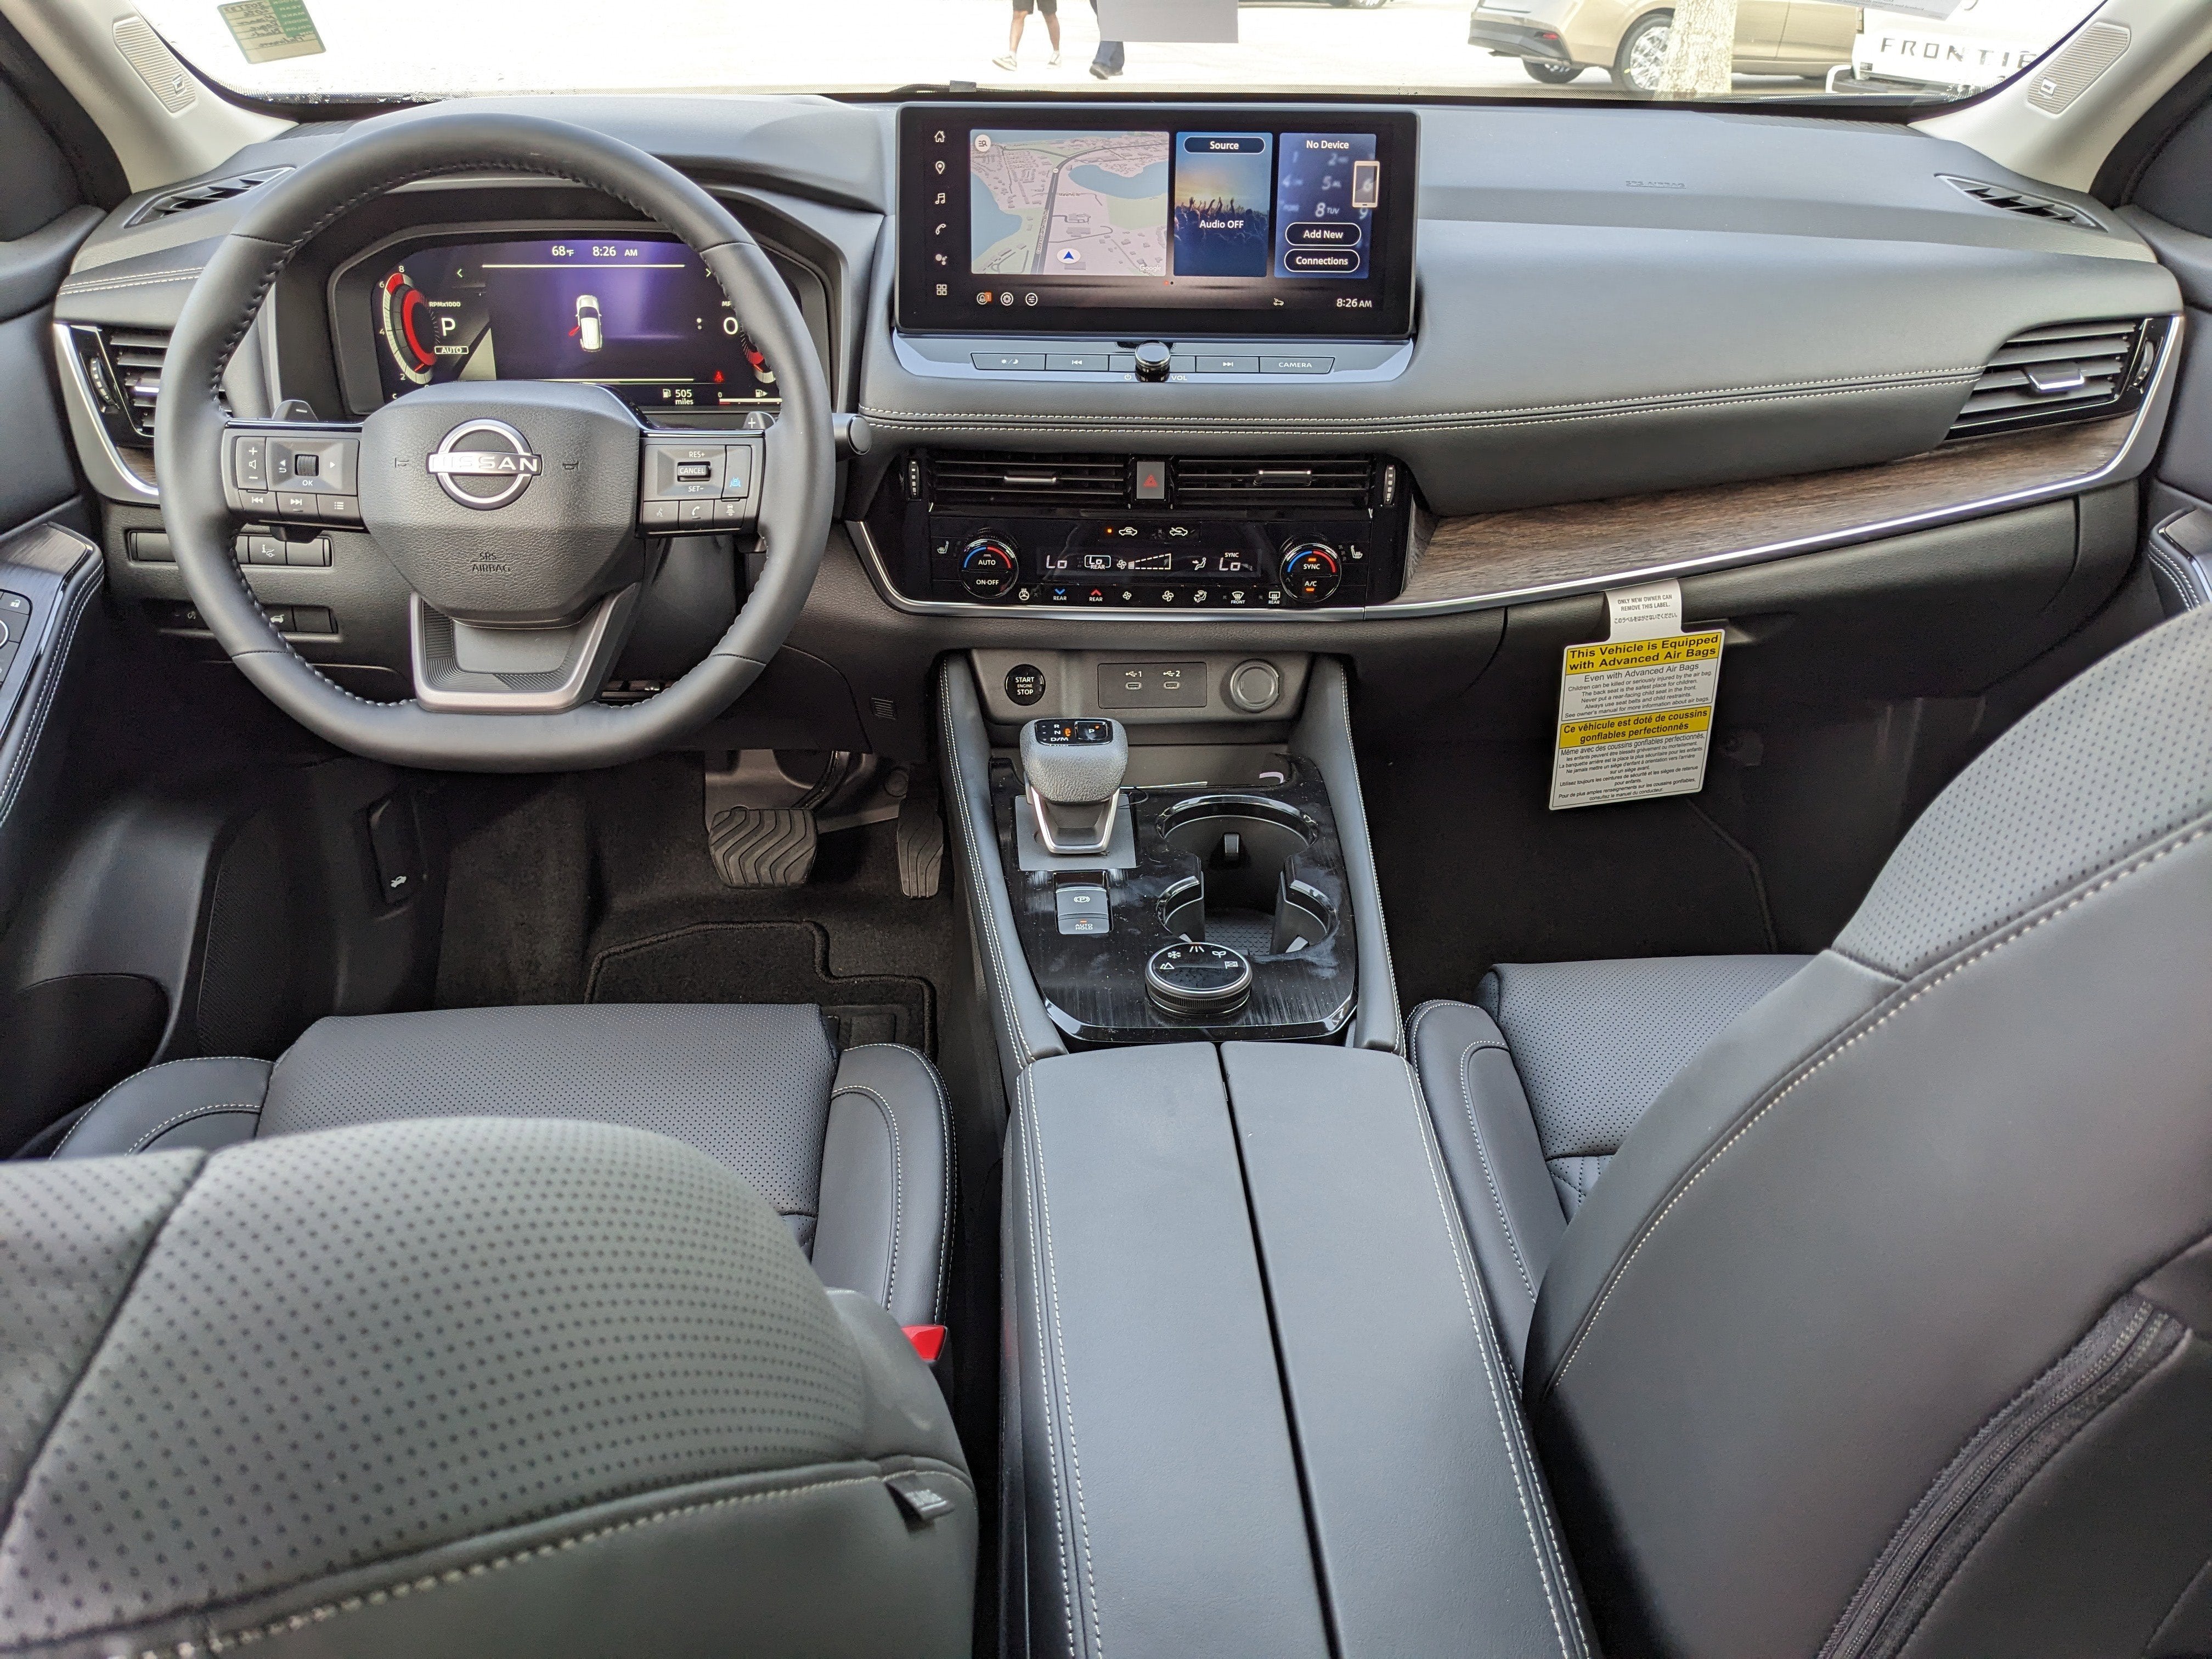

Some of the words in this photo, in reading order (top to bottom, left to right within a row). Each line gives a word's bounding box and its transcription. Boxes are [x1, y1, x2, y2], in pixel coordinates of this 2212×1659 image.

[1210, 140, 1239, 150] Source
[1306, 140, 1319, 149] No
[1321, 140, 1350, 149] Device
[1315, 202, 1325, 217] 8
[1199, 219, 1226, 229] Audio
[1227, 220, 1244, 229] OFF
[1304, 229, 1321, 239] Add
[1323, 230, 1344, 239] New
[592, 246, 616, 256] 8:26
[1296, 256, 1348, 265] Connections
[1139, 264, 1162, 273] Google
[1336, 298, 1358, 307] 8:26
[441, 318, 456, 336] P
[675, 390, 692, 398] 505
[432, 456, 537, 472] NISSAN
[479, 551, 497, 560] SRS
[472, 563, 511, 573] AIRBAG
[1570, 649, 1595, 659] This
[1599, 644, 1644, 656] Vehicle
[1647, 642, 1657, 651] is
[1662, 635, 1718, 650] Equipped
[1569, 660, 1594, 670] with
[1599, 652, 1660, 667] Advanced
[1663, 651, 1681, 660] Air
[1686, 648, 1716, 657] Bags
[1624, 667, 1664, 678] Advanced
[1564, 725, 1576, 733] Ce
[1578, 720, 1615, 732] véhicule
[1617, 718, 1631, 727] est
[1633, 715, 1652, 725] doté
[1655, 714, 1666, 722] de
[1668, 709, 1707, 721] coussins
[1580, 730, 1626, 744] gonflables
[1628, 722, 1689, 738] perfectionnés
[1607, 742, 1633, 751] coussins
[1634, 738, 1663, 748] gonflables
[1664, 733, 1705, 744] perfectionnés,
